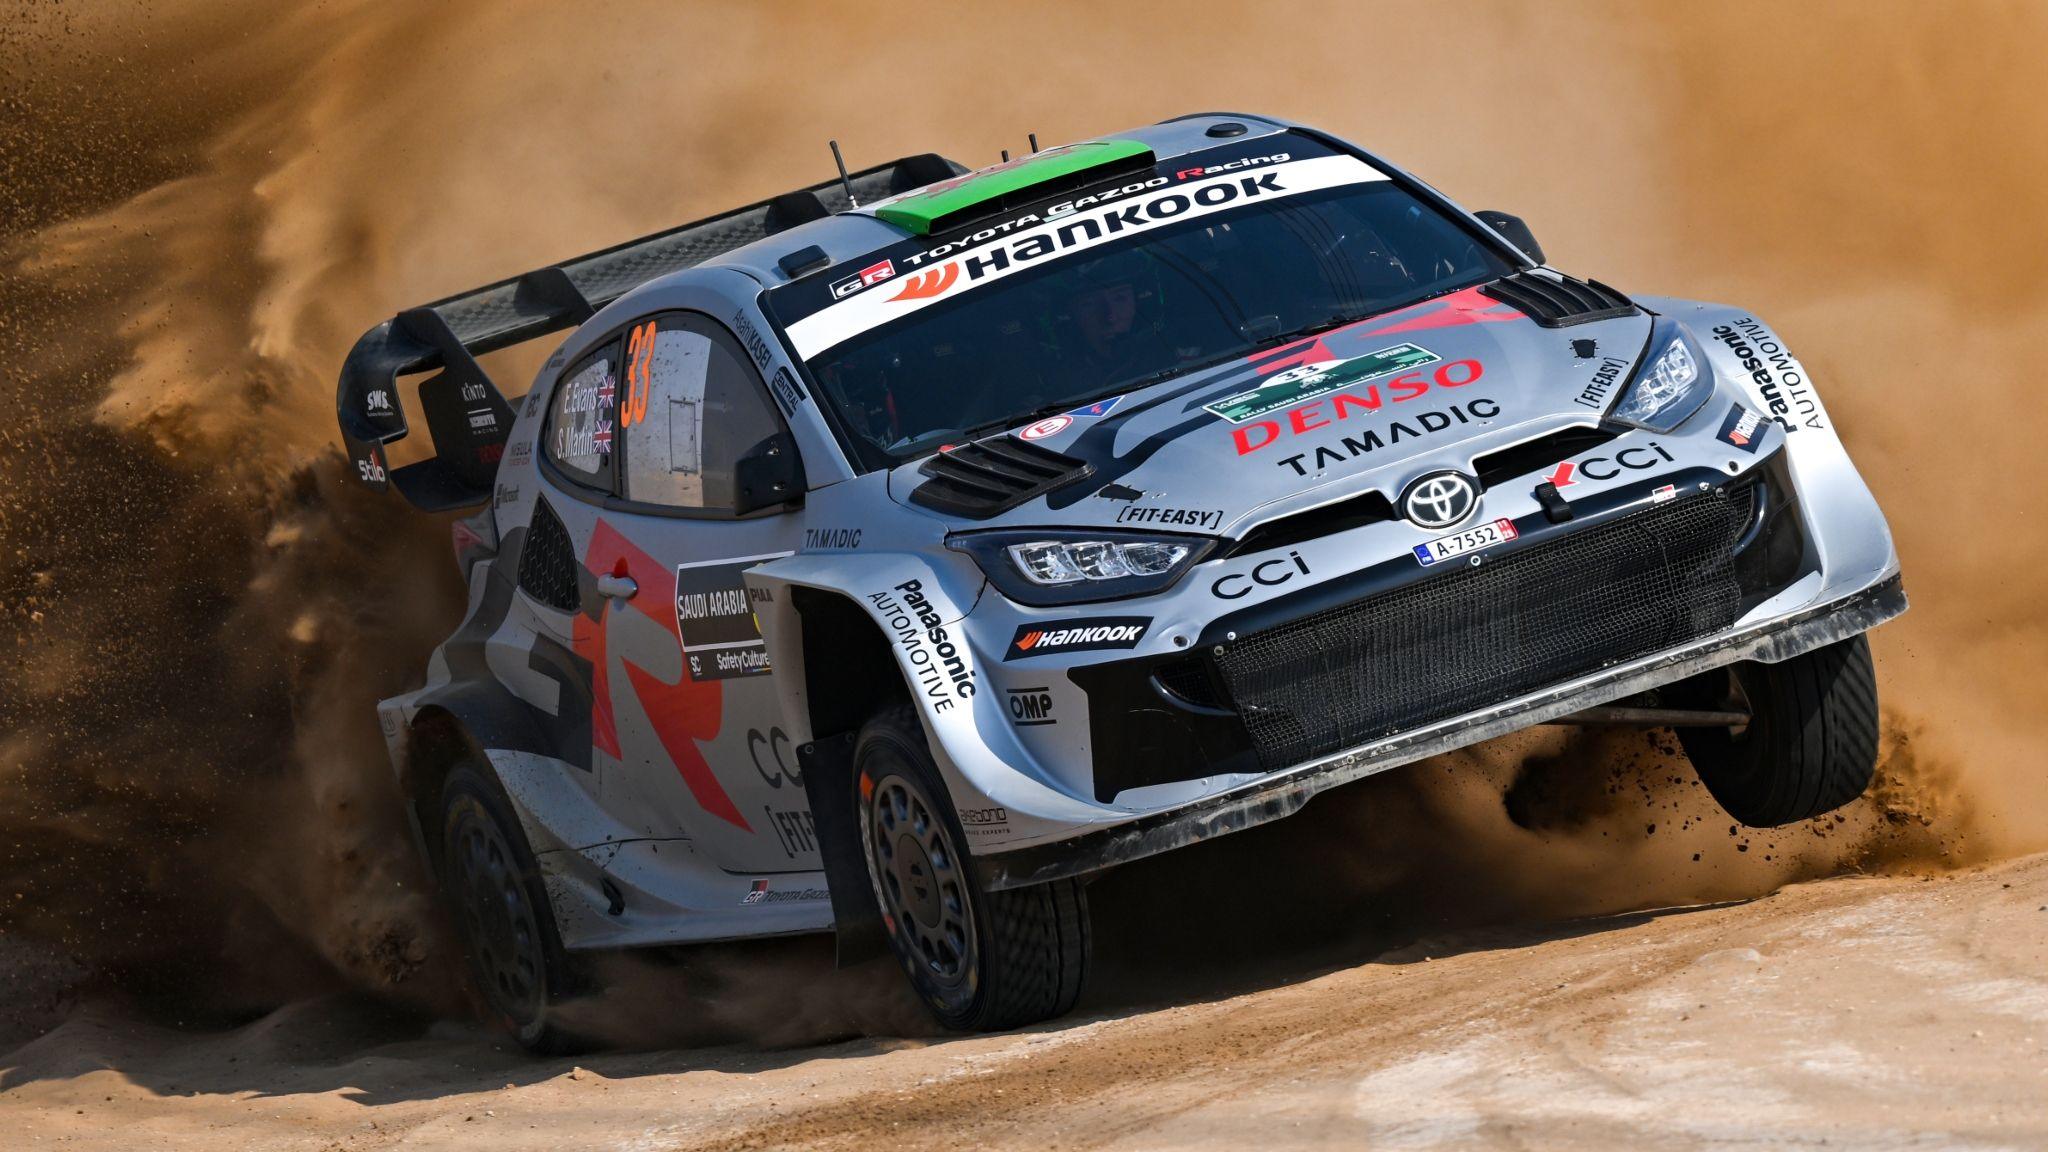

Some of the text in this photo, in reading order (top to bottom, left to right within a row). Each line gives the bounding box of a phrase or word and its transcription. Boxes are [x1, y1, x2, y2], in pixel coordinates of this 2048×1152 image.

[903, 152, 1291, 265] TOYOTA GAZOO Racing
[836, 266, 894, 297] GR
[620, 320, 657, 429] 33
[1277, 364, 1320, 381] 33
[1732, 317, 1824, 429] AUTOMOTIVE
[367, 389, 390, 411] SWS
[563, 382, 599, 414] E.Evans
[774, 370, 799, 413] CENTRAL
[1230, 357, 1485, 457] DENSO
[1239, 406, 1267, 420] RALLY
[1267, 396, 1297, 410] SAUDI
[1296, 386, 1331, 400] ARABIA
[557, 425, 594, 460] S.Martin
[1277, 398, 1502, 477] TAMADIC
[806, 528, 862, 550] TAMADIC
[1435, 527, 1498, 557] A-7552
[678, 588, 749, 620] SAUDI ARABIA
[748, 587, 774, 602] PIAA
[866, 591, 955, 715] AUTOMOTIVE
[893, 578, 977, 700] Panasonic
[716, 650, 771, 675] SafetyCulture
[1010, 693, 1054, 719] OMP
[743, 890, 765, 903] GR
